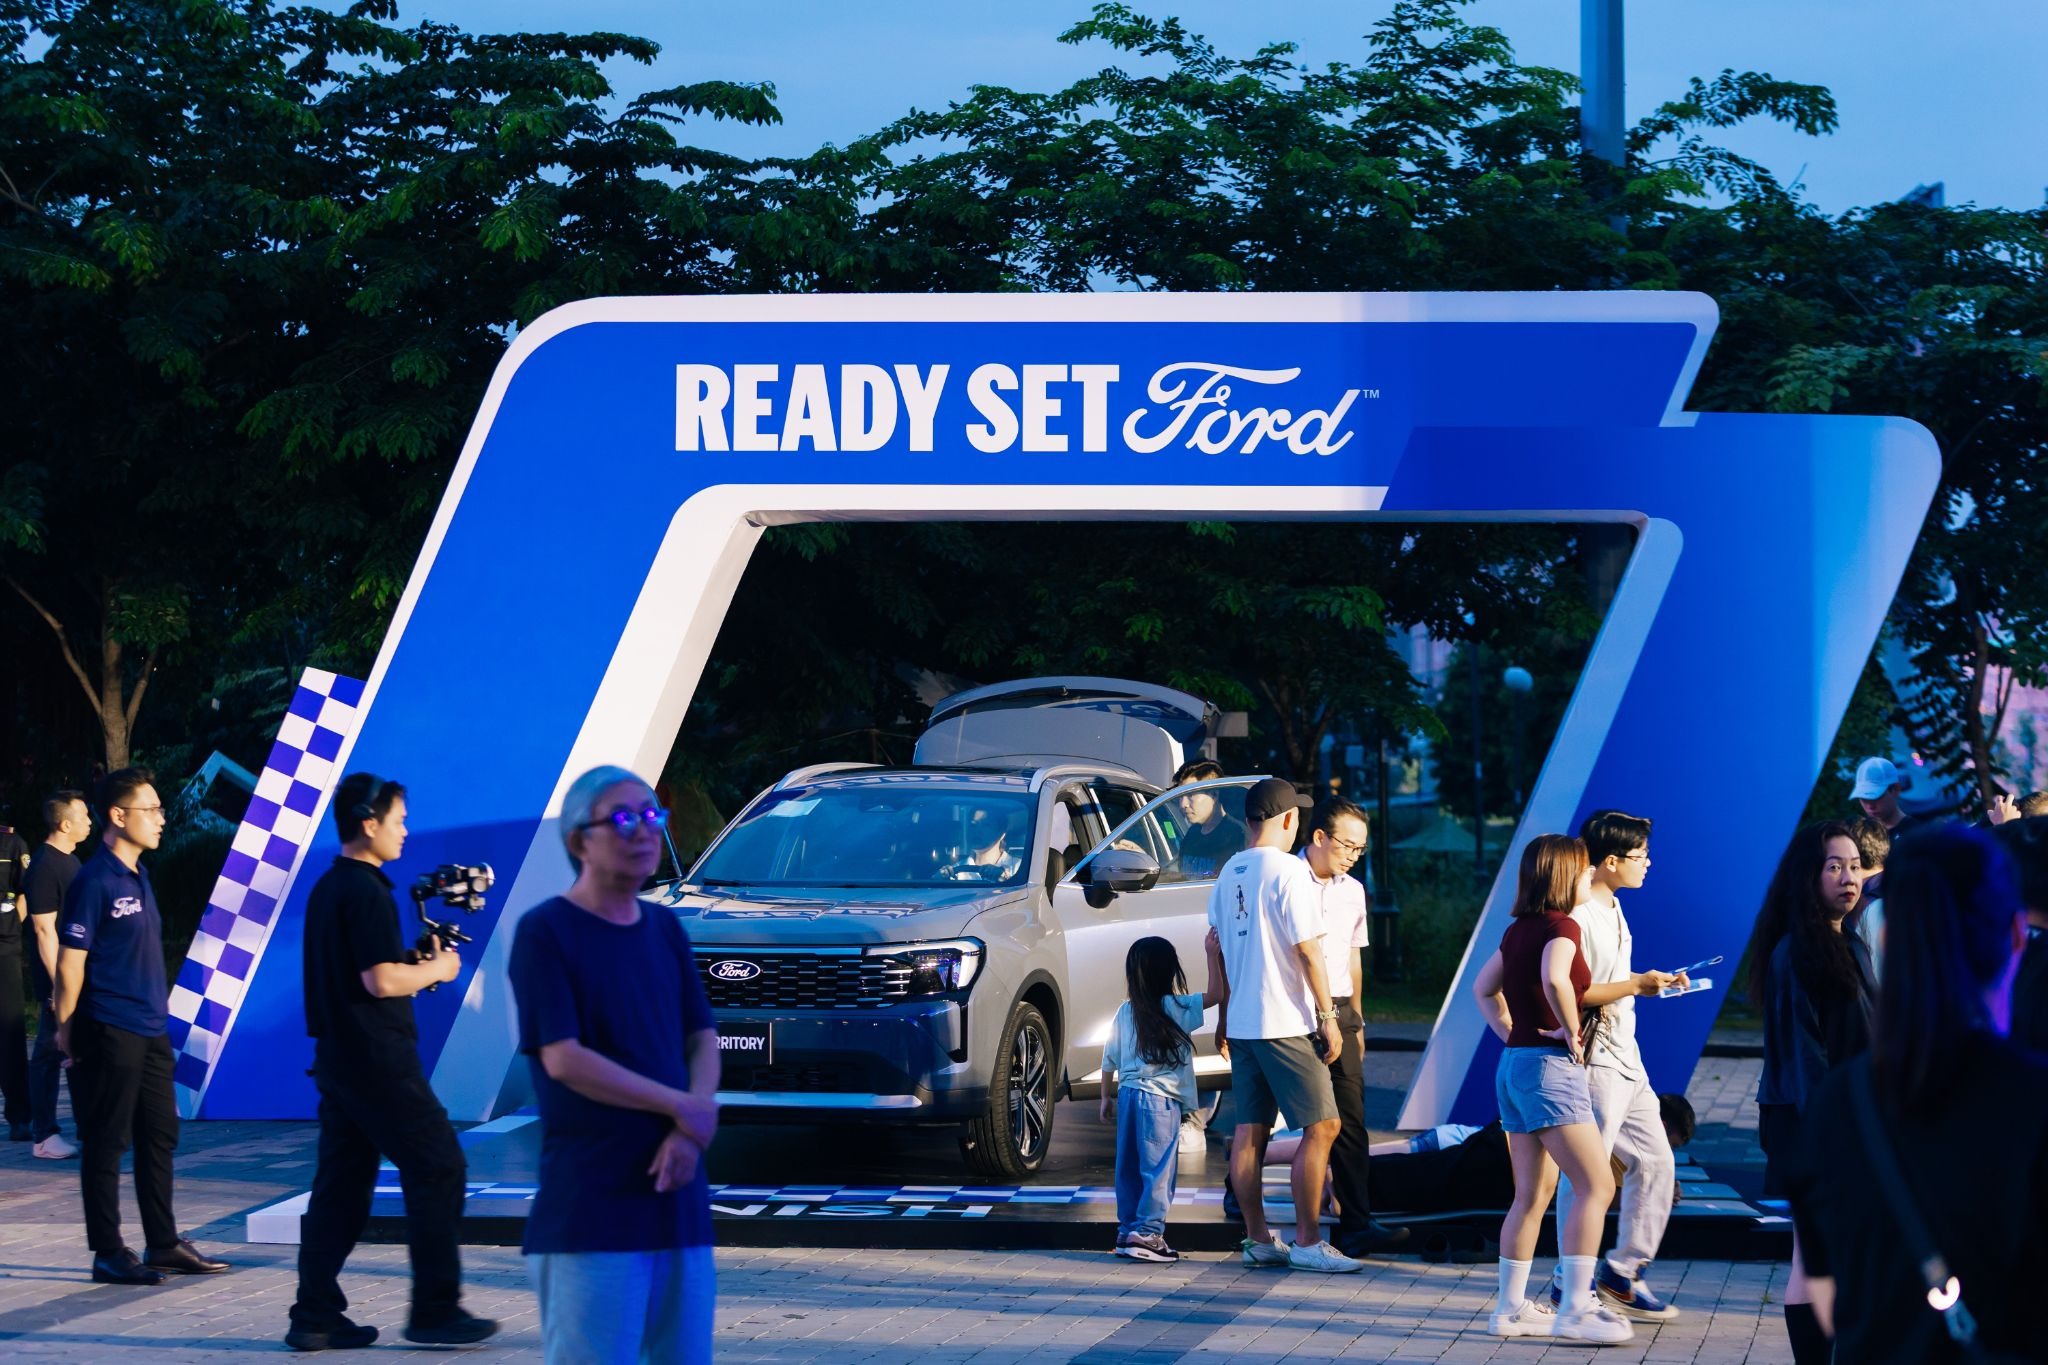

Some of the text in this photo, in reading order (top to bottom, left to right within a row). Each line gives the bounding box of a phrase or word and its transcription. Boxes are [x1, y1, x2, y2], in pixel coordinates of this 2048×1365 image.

[676, 364, 950, 451] READY
[966, 364, 1119, 453] SET
[1122, 361, 1361, 456] Ford
[110, 897, 142, 918] Ford
[718, 963, 750, 977] Ford
